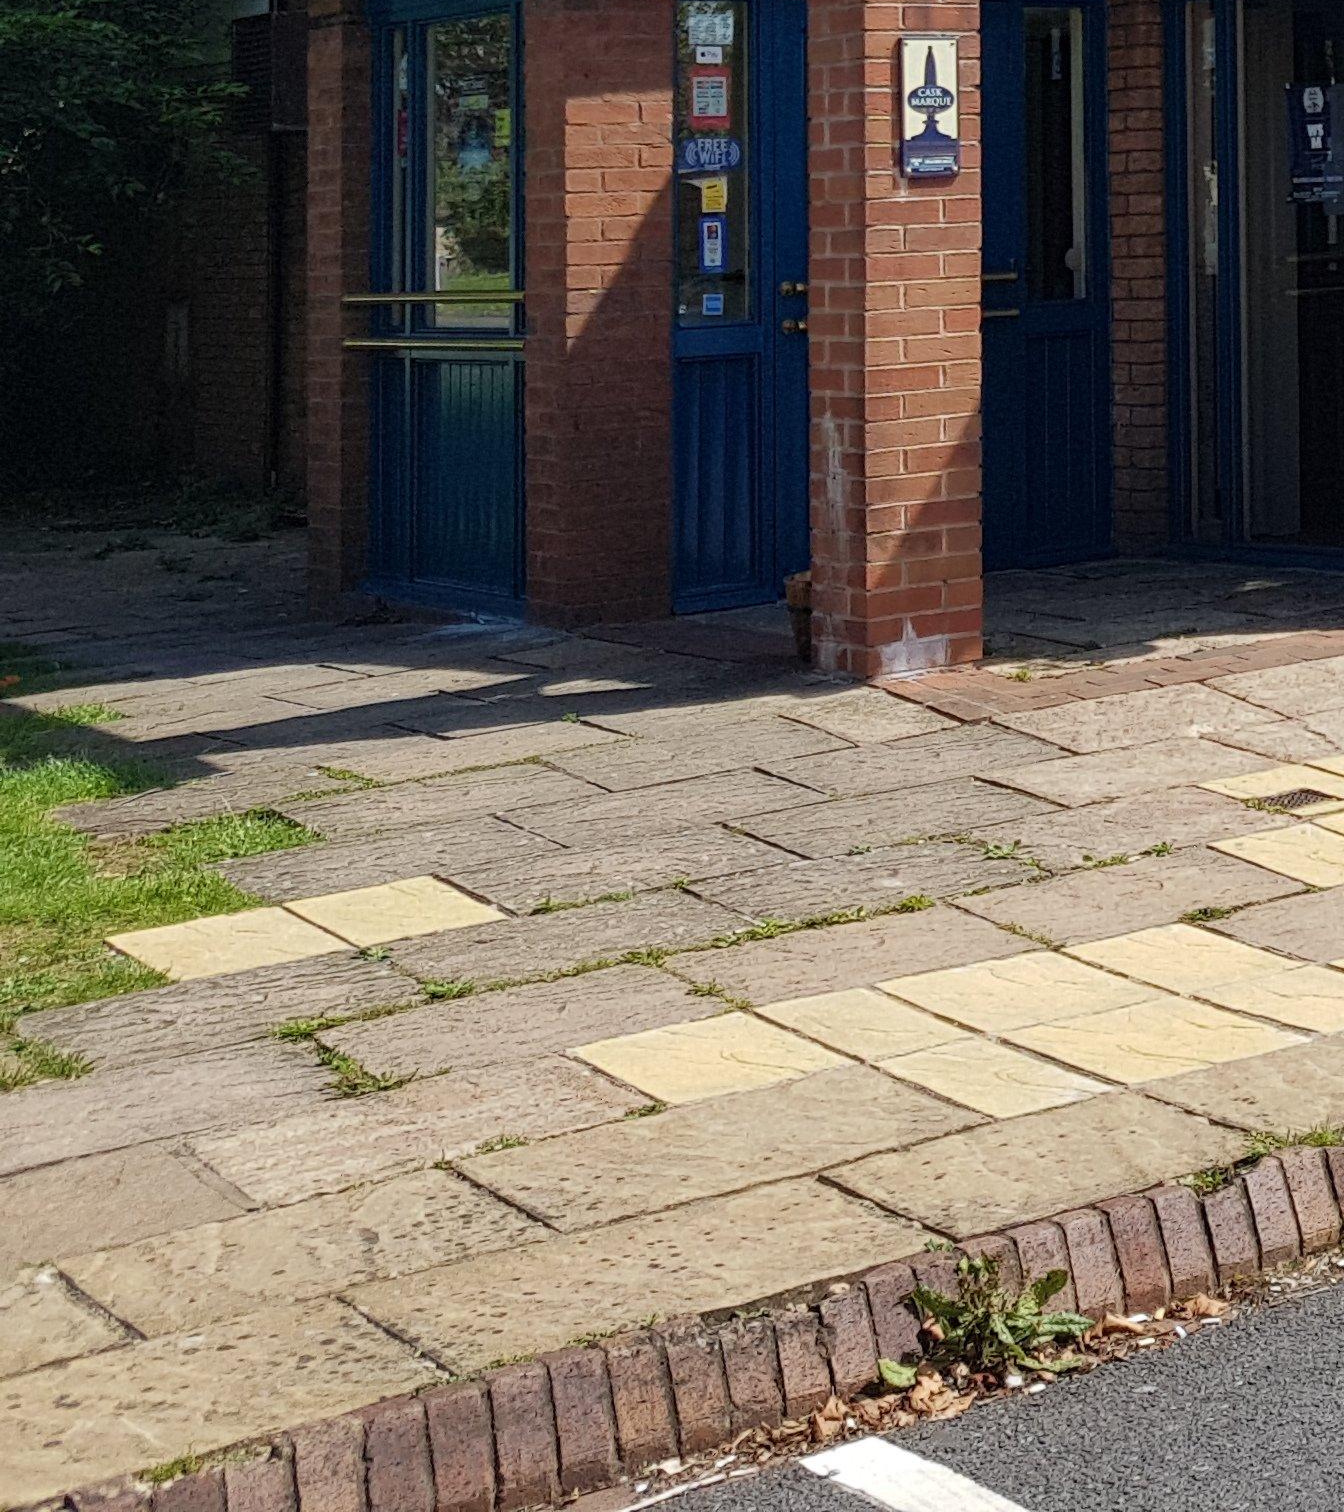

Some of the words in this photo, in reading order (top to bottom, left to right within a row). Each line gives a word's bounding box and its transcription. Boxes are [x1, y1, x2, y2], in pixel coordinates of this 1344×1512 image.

[917, 88, 943, 97] CASK
[910, 97, 952, 106] MARQUE
[697, 138, 728, 151] FREE
